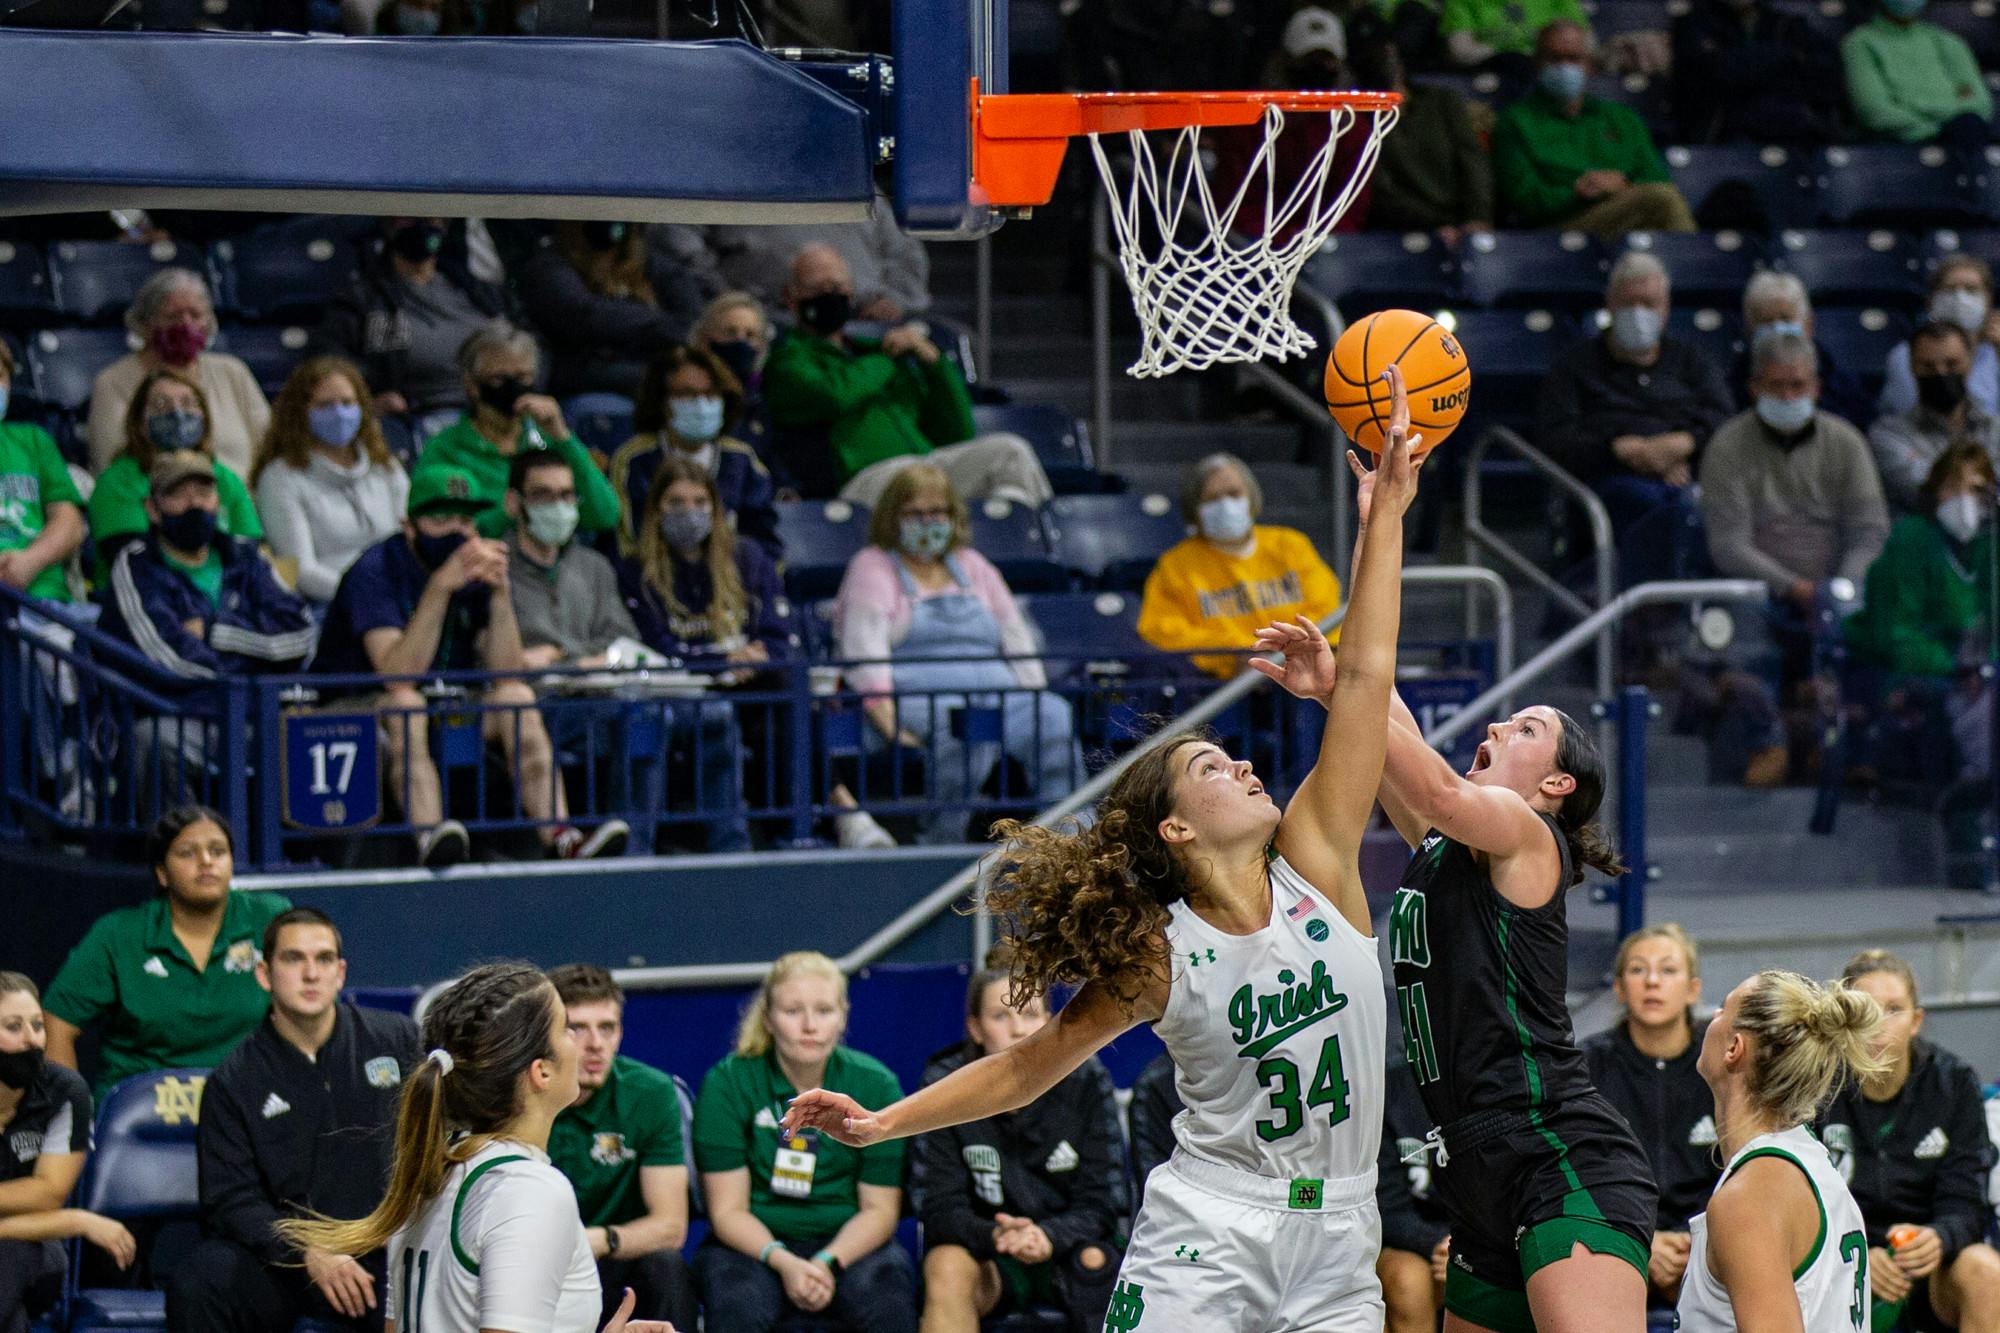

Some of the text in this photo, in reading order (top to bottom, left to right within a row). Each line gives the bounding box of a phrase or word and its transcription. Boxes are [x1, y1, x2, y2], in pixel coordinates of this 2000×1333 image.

[309, 741, 358, 795] 17
[1228, 959, 1349, 1046] Irish
[1255, 1033, 1351, 1143] 34
[403, 1247, 429, 1333] 11
[1839, 1229, 1867, 1332] 3
